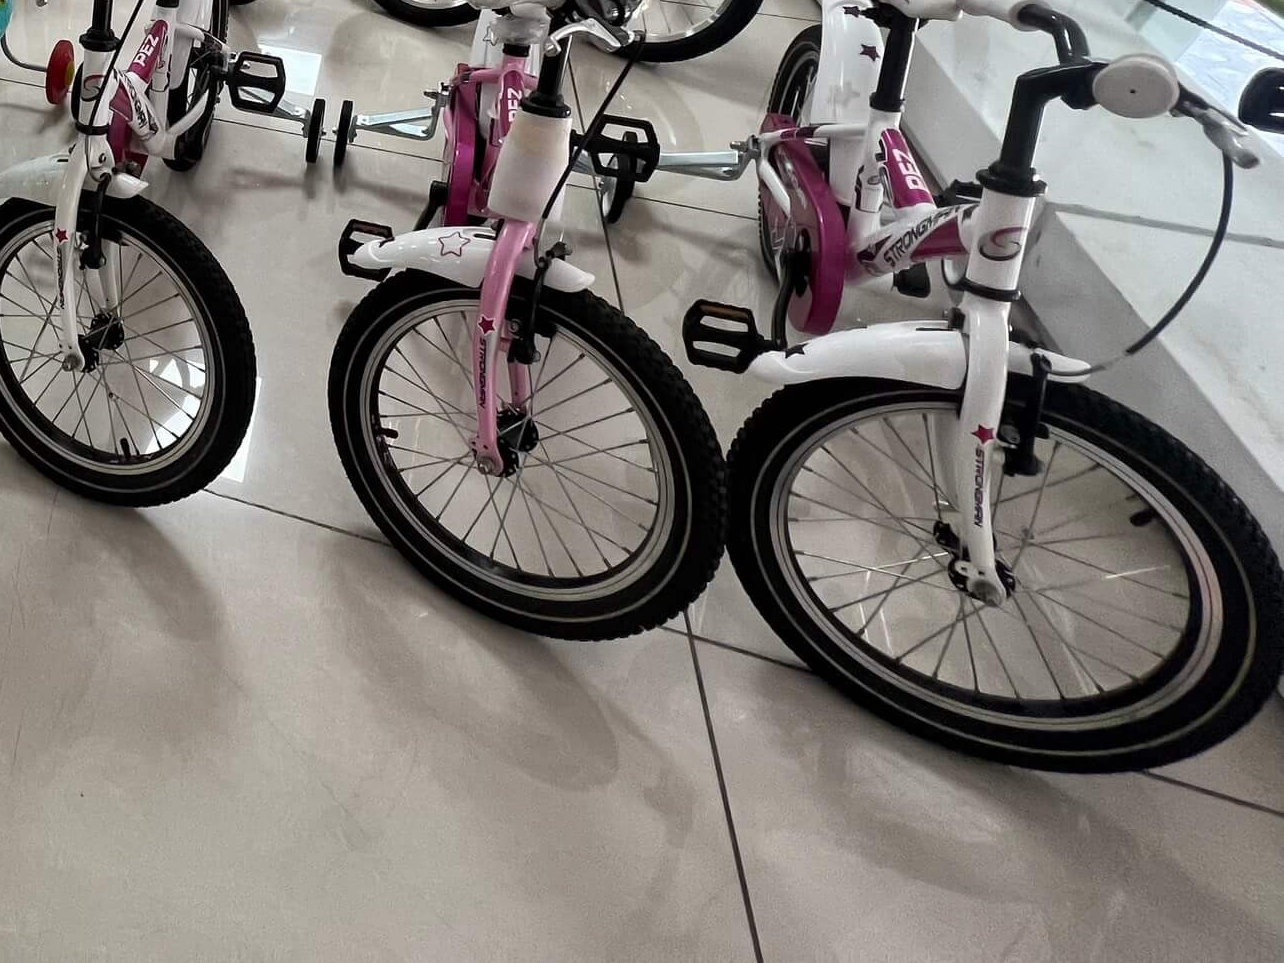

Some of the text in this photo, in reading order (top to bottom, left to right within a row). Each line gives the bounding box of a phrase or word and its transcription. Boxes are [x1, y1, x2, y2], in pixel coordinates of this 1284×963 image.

[132, 33, 159, 67] PEZ
[892, 148, 929, 192] PEZ
[973, 446, 985, 529] STRONGMAN
